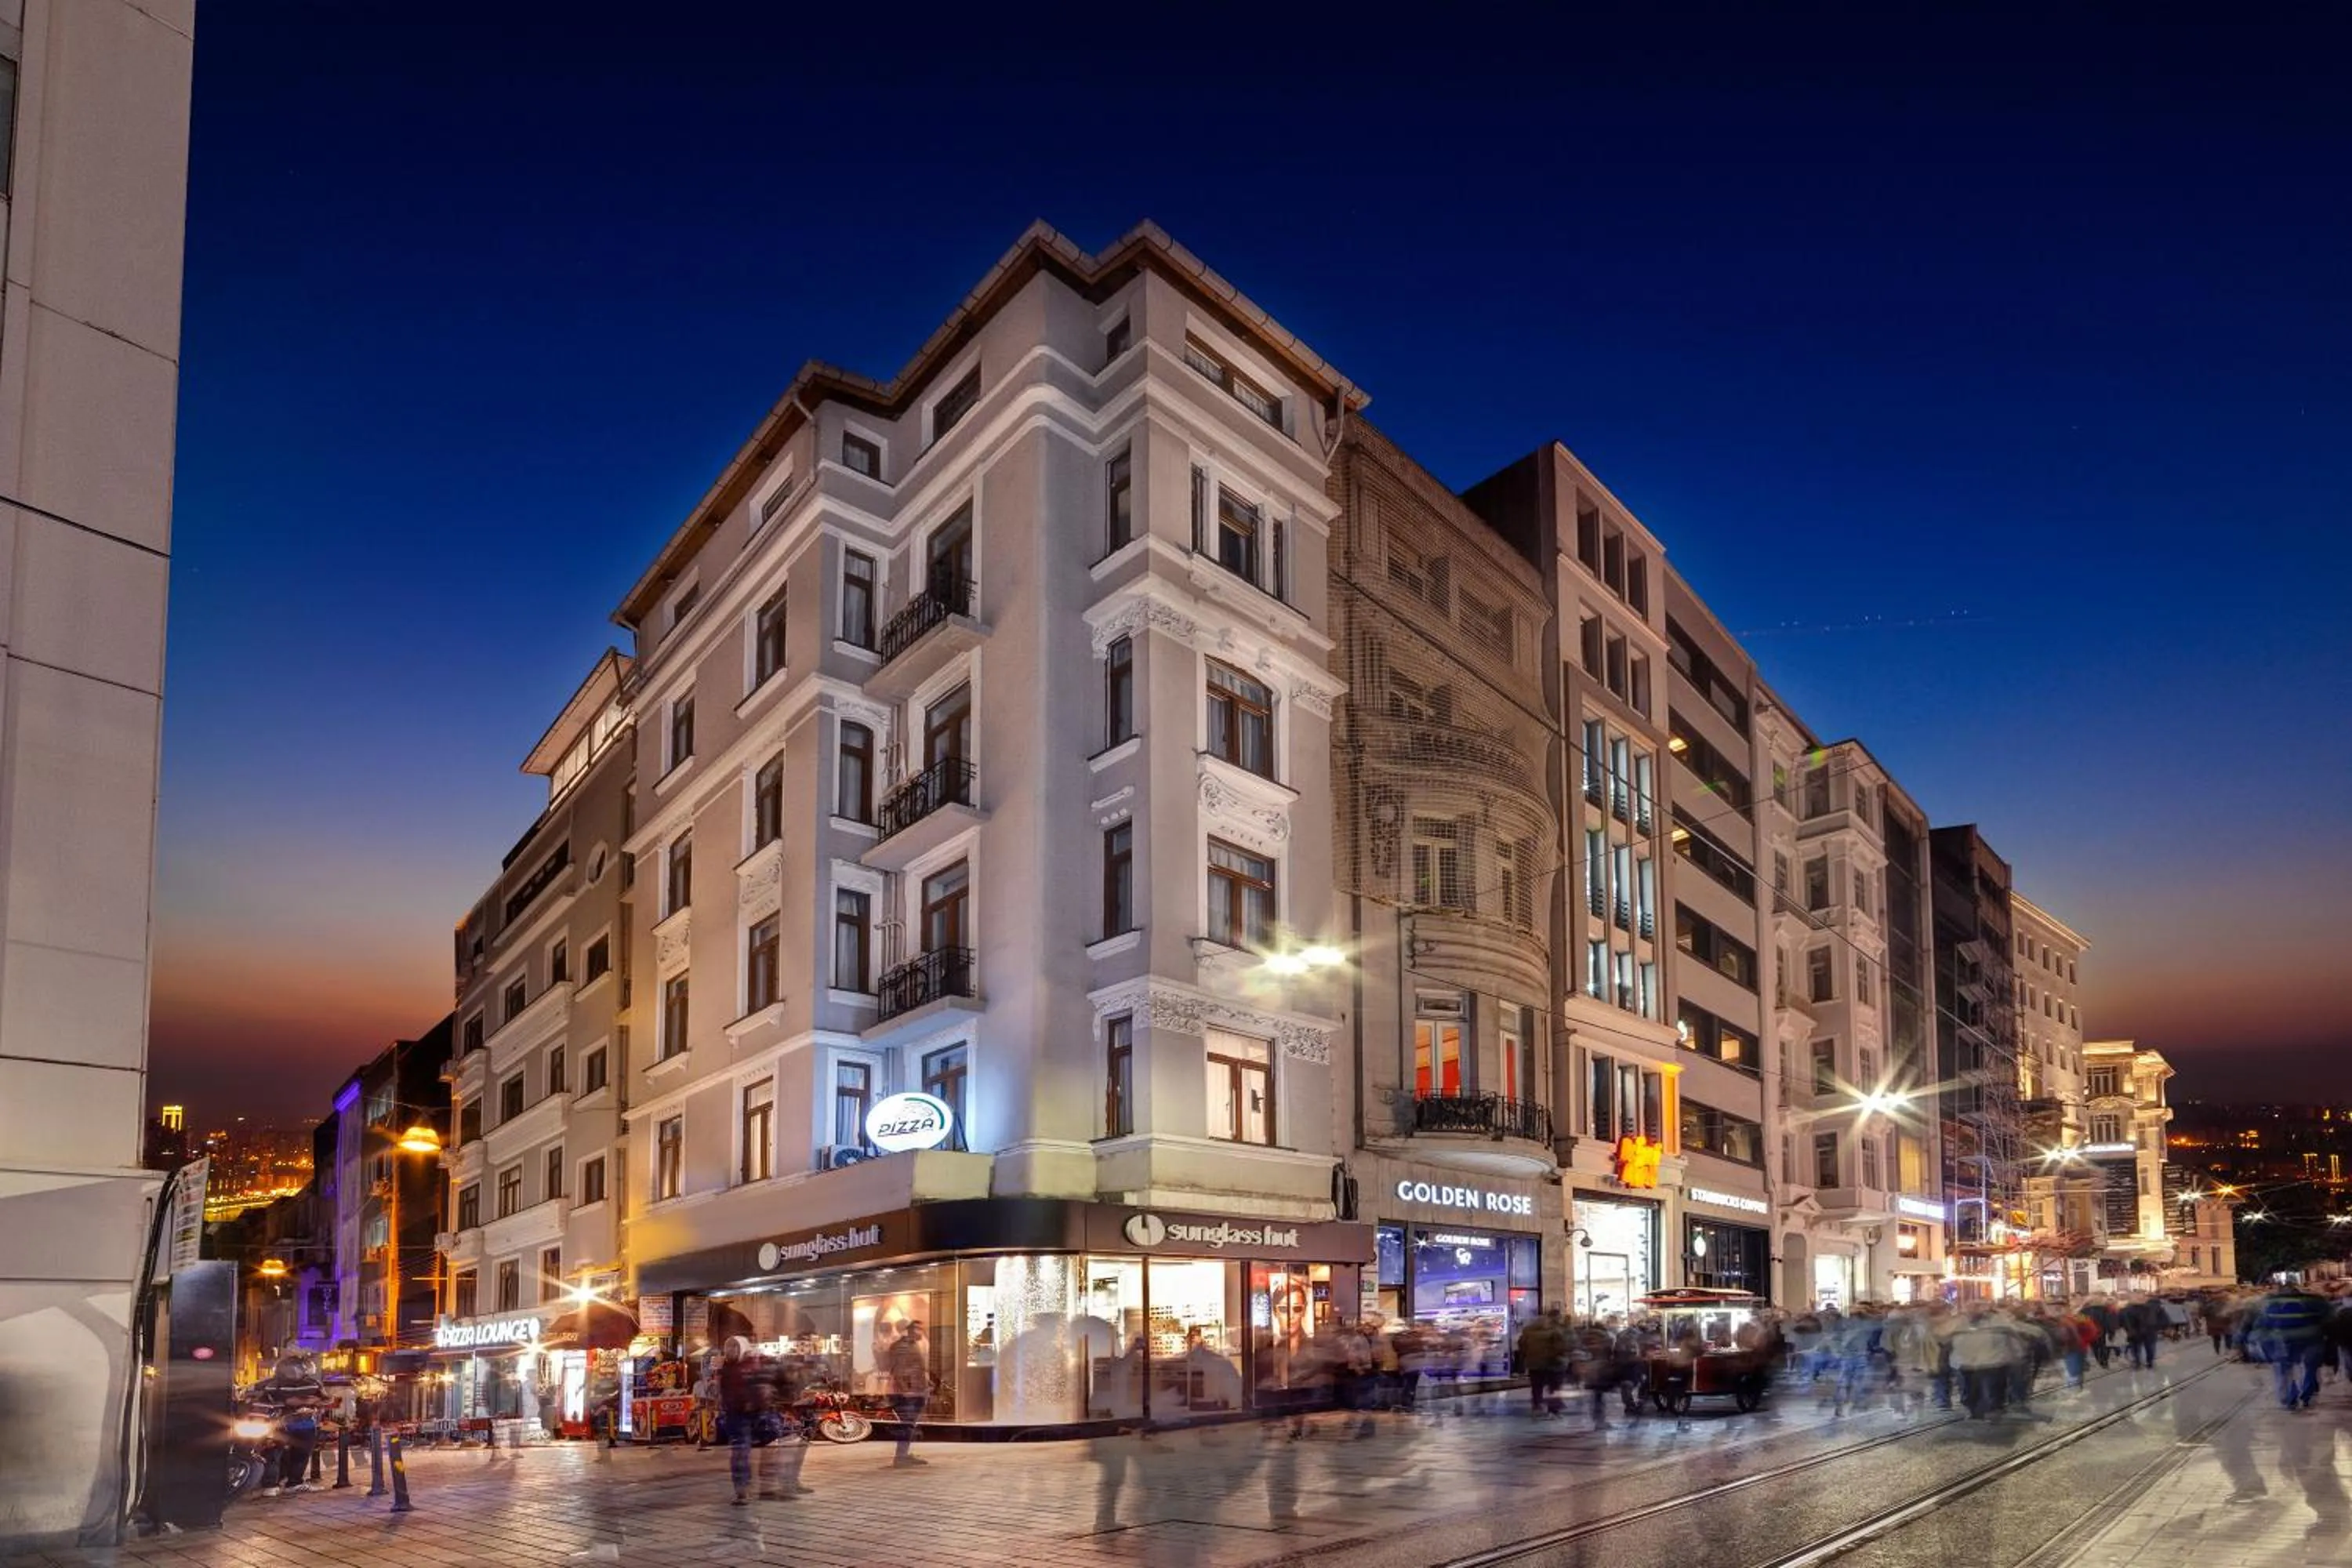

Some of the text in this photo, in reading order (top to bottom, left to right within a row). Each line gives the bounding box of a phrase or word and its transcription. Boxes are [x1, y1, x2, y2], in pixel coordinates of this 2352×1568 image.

[1397, 1180, 1531, 1214] GOLDEN ROSE
[781, 1224, 880, 1261] sunglass hut
[1167, 1221, 1300, 1248] sunglass hut
[476, 1319, 529, 1344] LOUNGE
